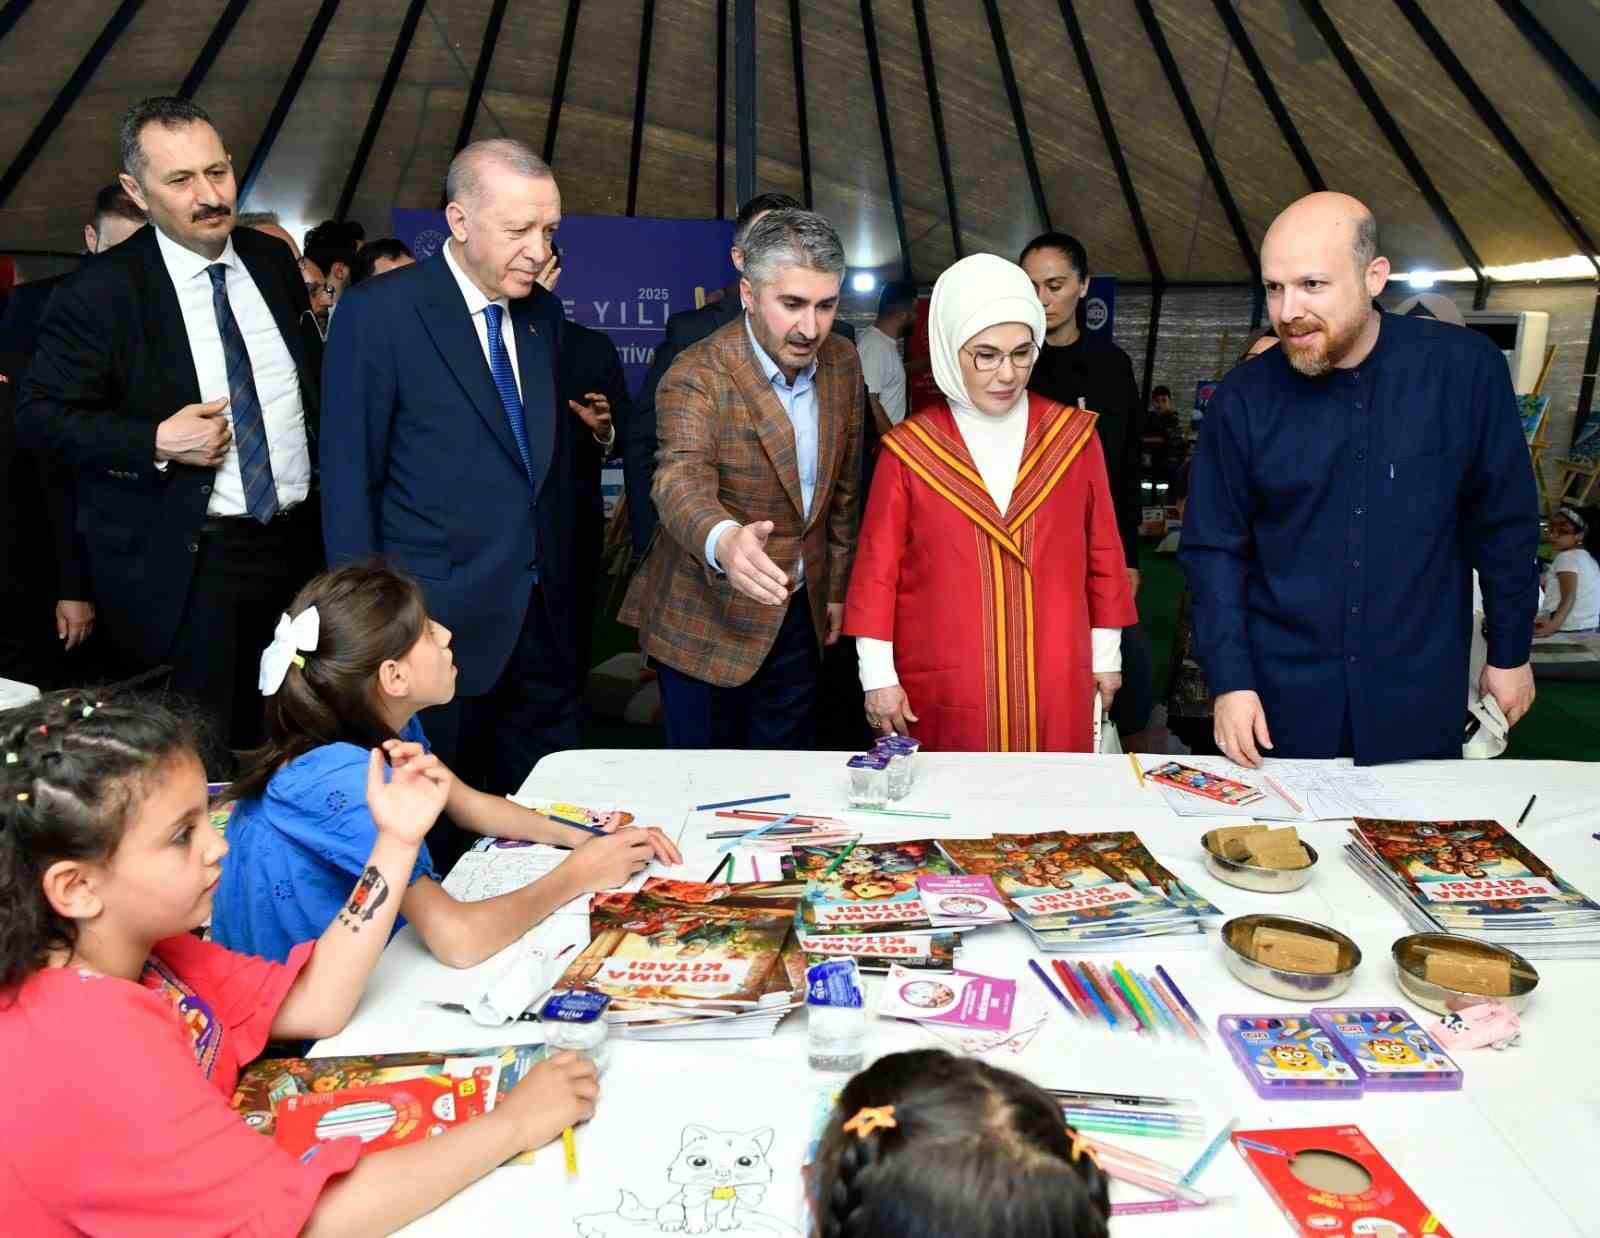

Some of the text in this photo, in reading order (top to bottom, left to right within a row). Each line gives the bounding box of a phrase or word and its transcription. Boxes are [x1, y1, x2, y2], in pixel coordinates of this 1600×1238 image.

[638, 288, 670, 300] 2025
[593, 301, 670, 325] YILI
[616, 343, 655, 364] TİVA
[1439, 880, 1526, 890] KİTABI
[1432, 886, 1548, 899] BOYAMA
[836, 902, 920, 913] KİTABI
[1030, 891, 1131, 912] BOYAMA
[803, 940, 918, 954] BOYAMA
[819, 937, 906, 946] KİTA
[628, 962, 723, 974] KİTABI
[608, 970, 732, 983] BOYAMA
